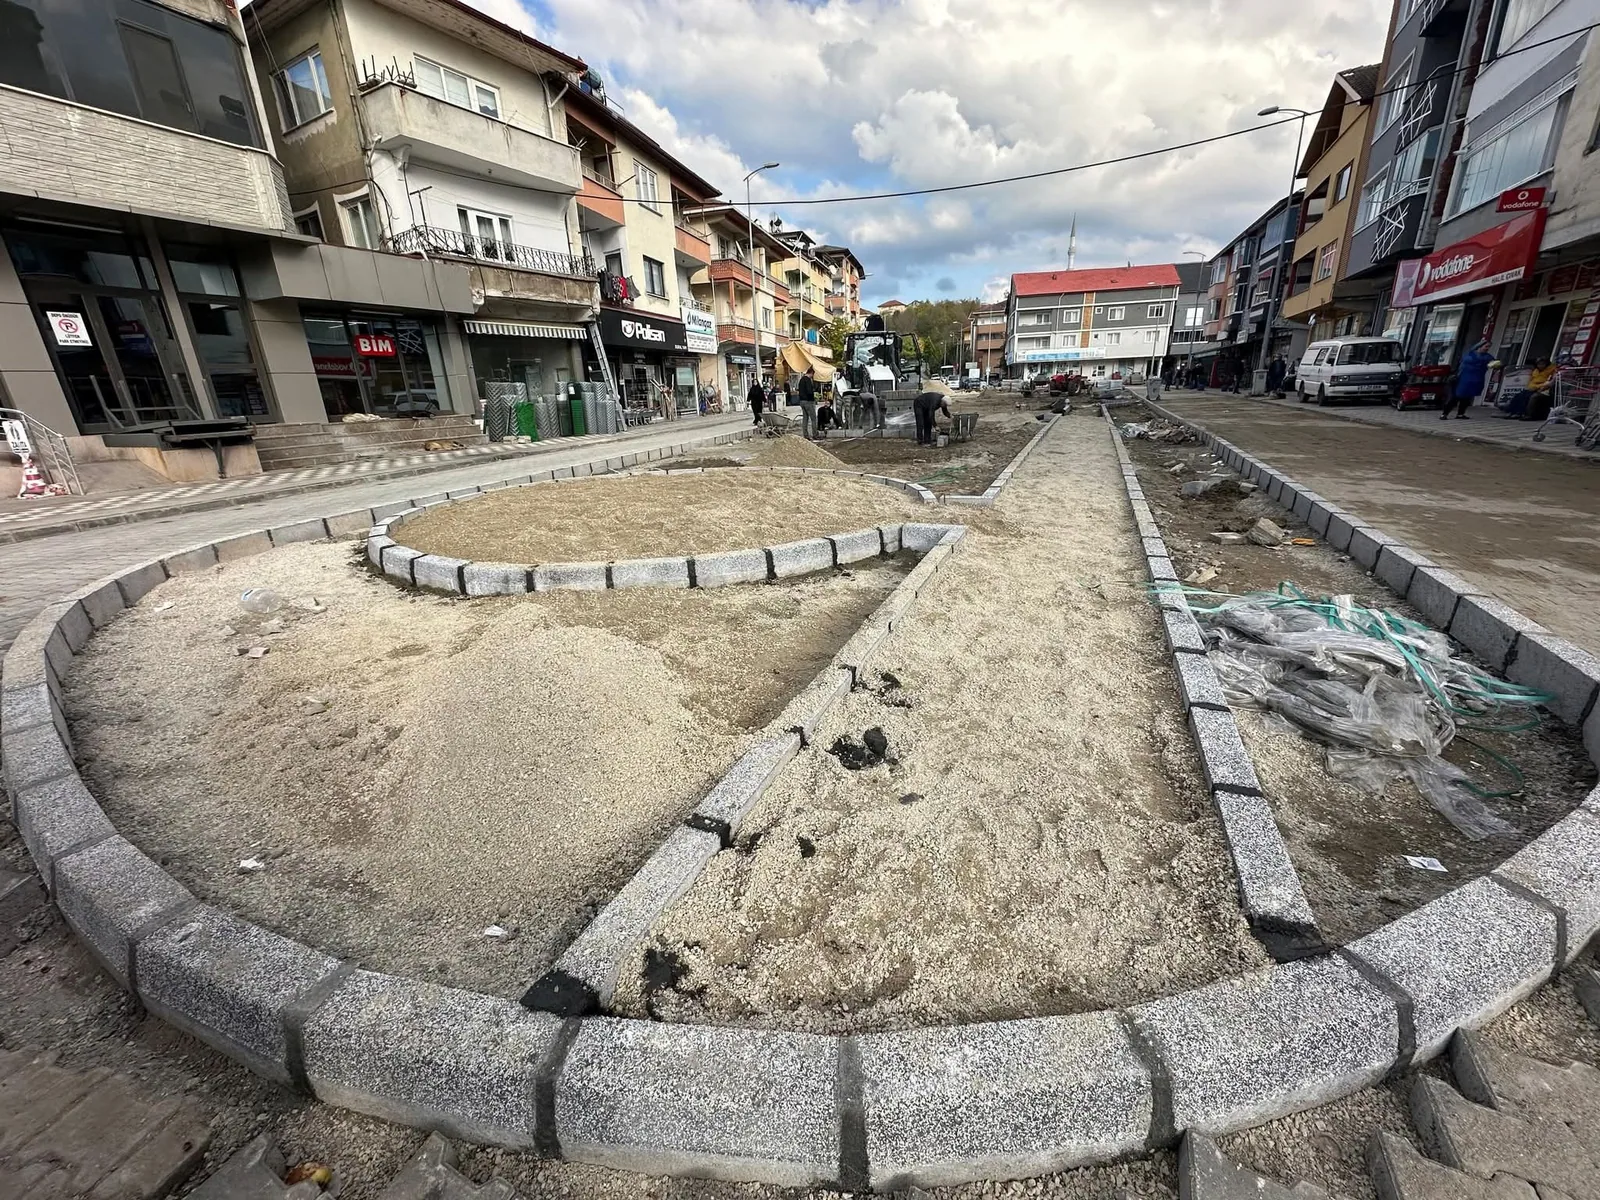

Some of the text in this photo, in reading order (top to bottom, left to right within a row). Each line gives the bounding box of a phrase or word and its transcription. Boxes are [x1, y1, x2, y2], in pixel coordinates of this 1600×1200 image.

[1503, 200, 1539, 209] vodafone
[1431, 254, 1474, 281] vodafone
[635, 322, 665, 342] Polisan
[692, 314, 712, 331] Milangaz
[359, 334, 392, 353] BİM
